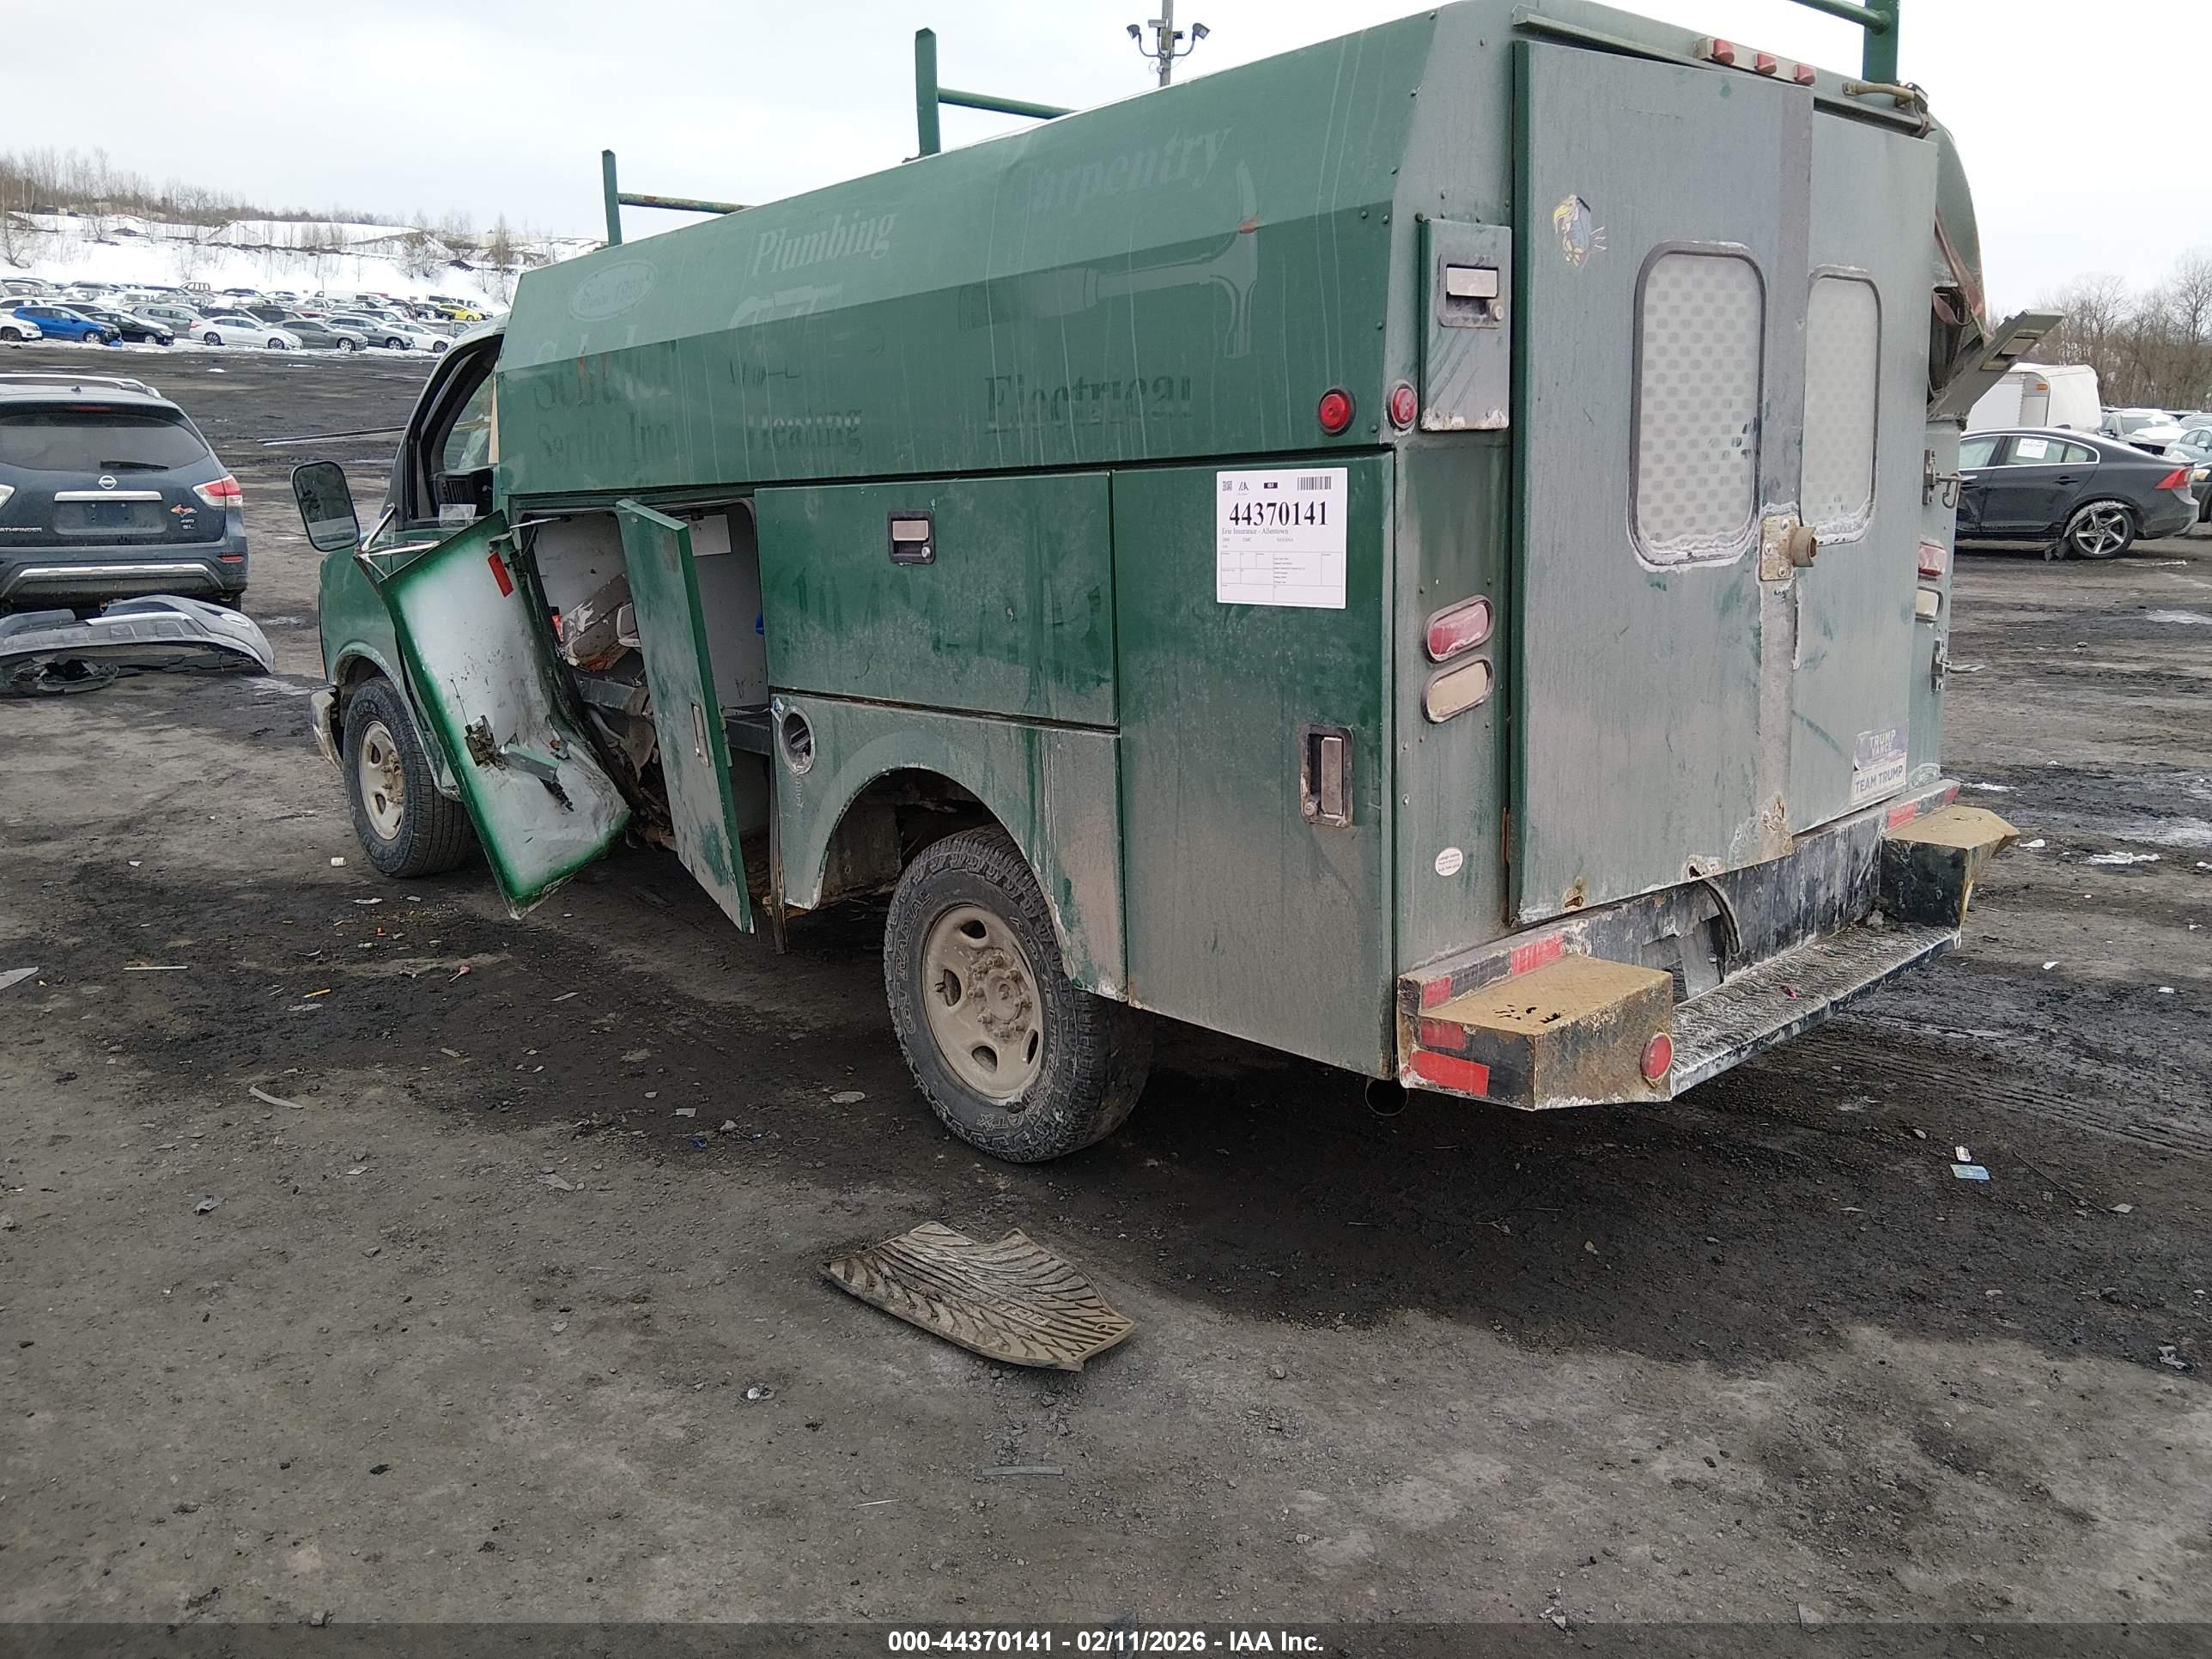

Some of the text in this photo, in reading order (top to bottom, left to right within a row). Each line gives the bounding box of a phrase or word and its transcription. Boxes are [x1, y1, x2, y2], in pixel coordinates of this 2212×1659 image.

[749, 210, 895, 277] Plumbing
[1229, 501, 1328, 526] 44370141
[1869, 730, 1896, 748] TRUMP
[1855, 765, 1903, 793] TEAM TRUMP
